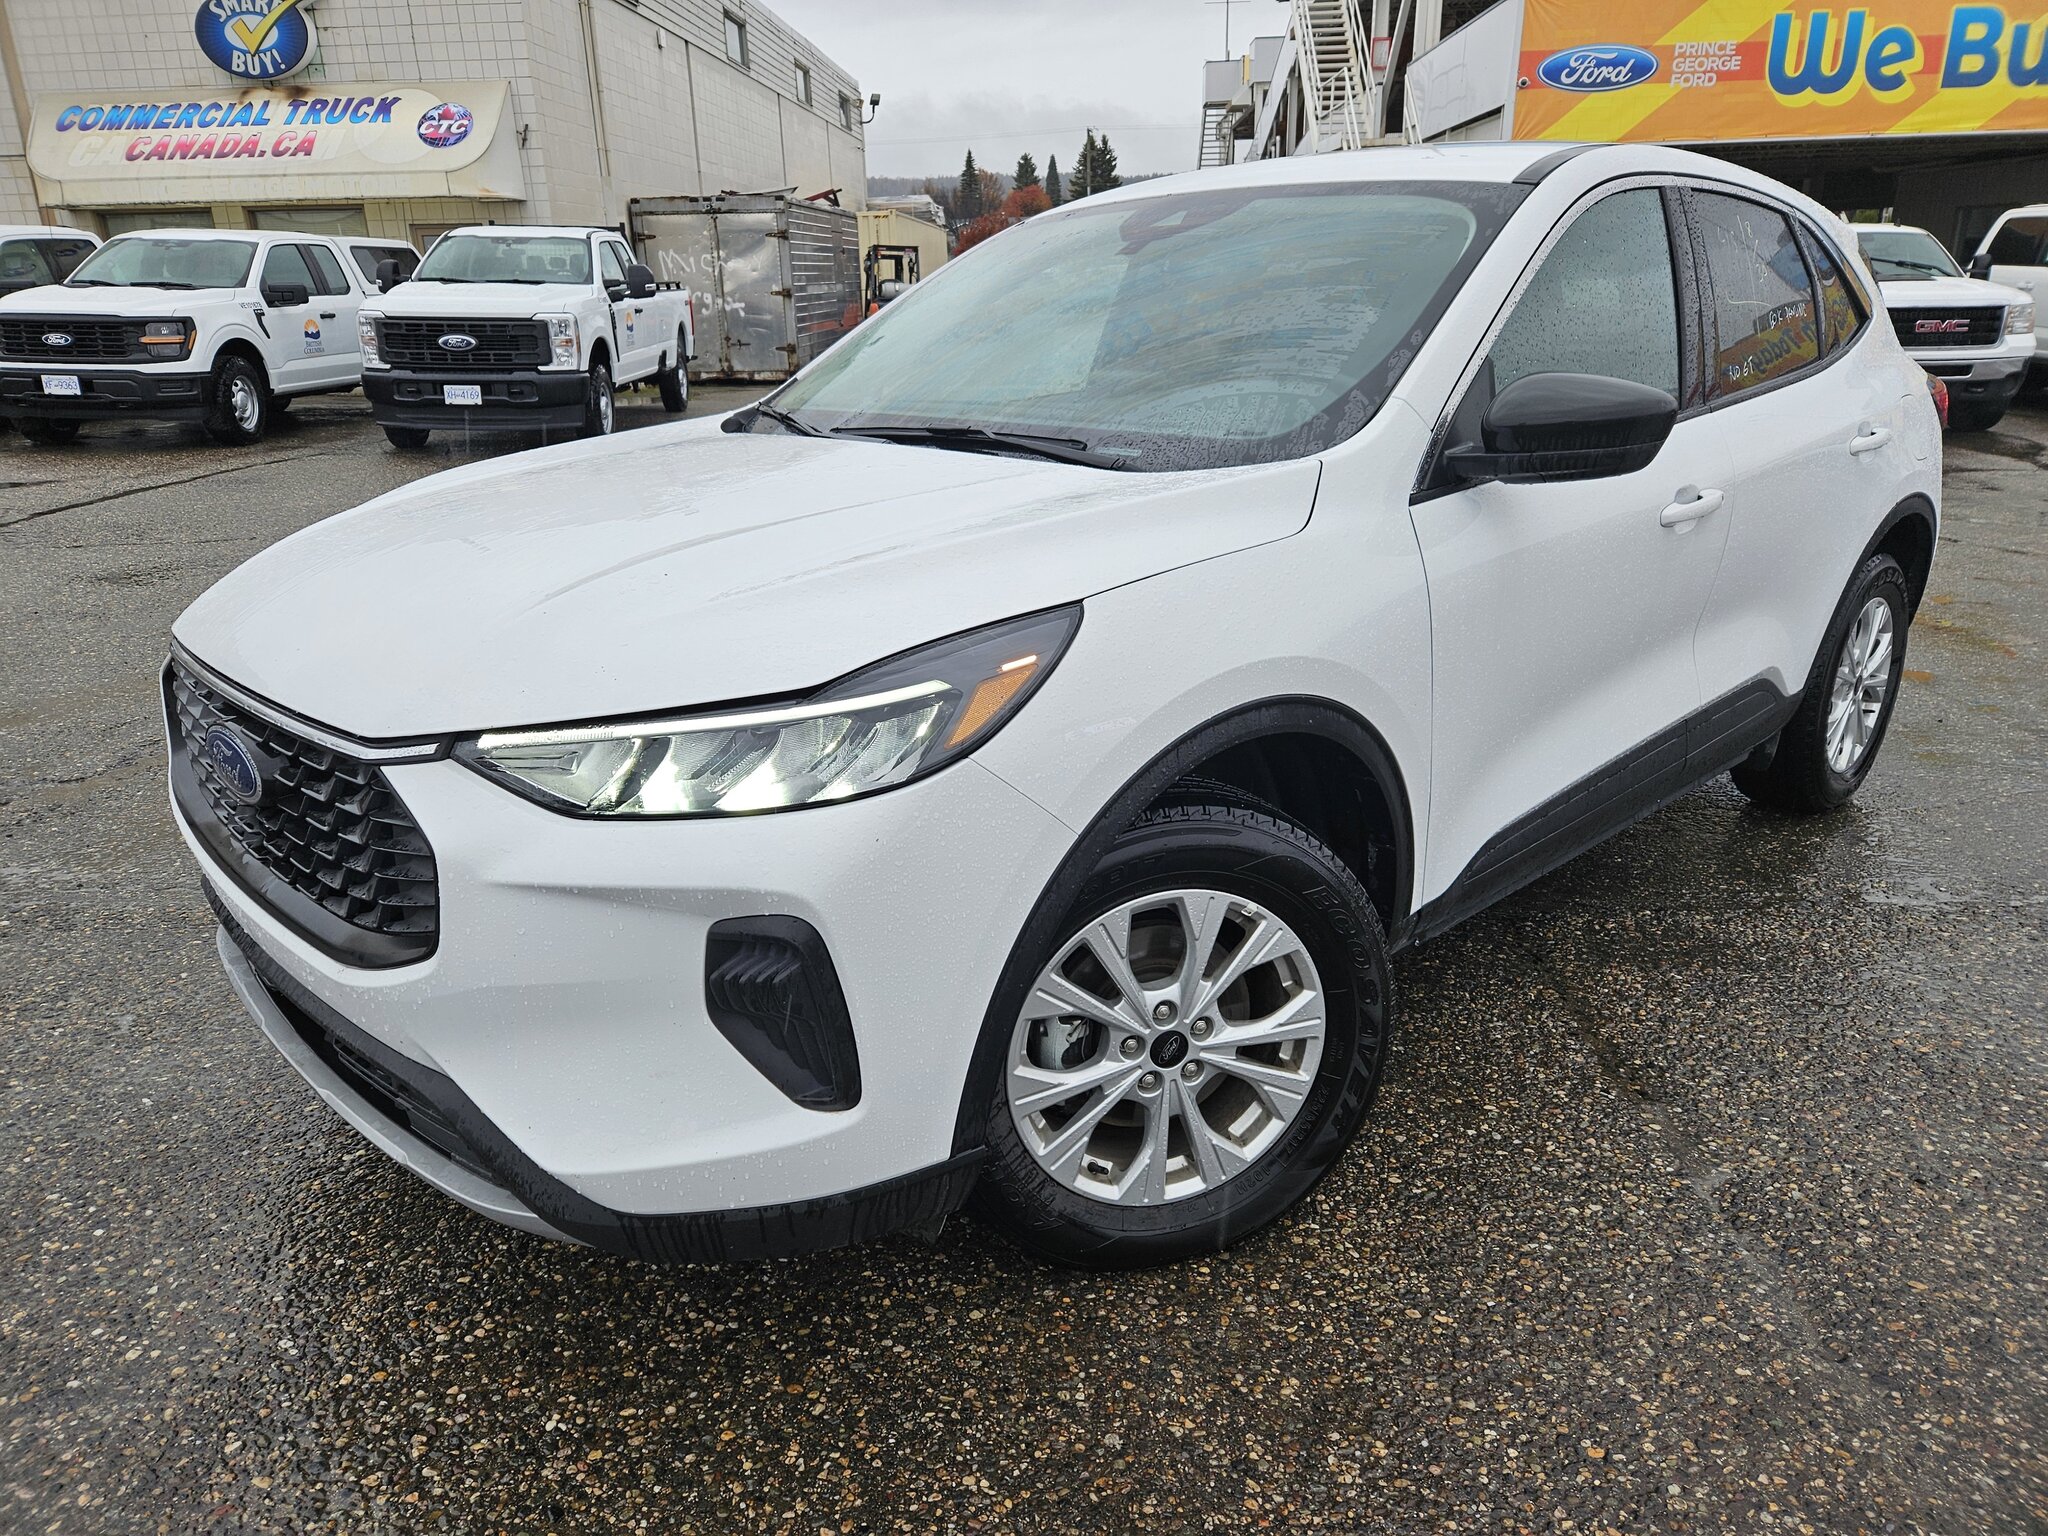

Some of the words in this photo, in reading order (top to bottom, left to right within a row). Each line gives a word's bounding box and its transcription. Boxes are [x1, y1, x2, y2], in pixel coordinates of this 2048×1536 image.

[208, 0, 281, 23] SMAR
[1673, 41, 1738, 57] PRINCE
[1767, 10, 1916, 95] We
[231, 48, 286, 76] BUY!
[1560, 51, 1636, 85] Ford
[1671, 56, 1742, 72] GEORGE
[1669, 72, 1717, 89] FORD
[55, 100, 271, 132] COMMERCIAL
[283, 97, 402, 125] TRUCK
[418, 119, 469, 135] CTC
[125, 131, 318, 162] CANADA.CA
[1914, 319, 1971, 333] GMC
[1302, 885, 1377, 1137] ECOSAVER
